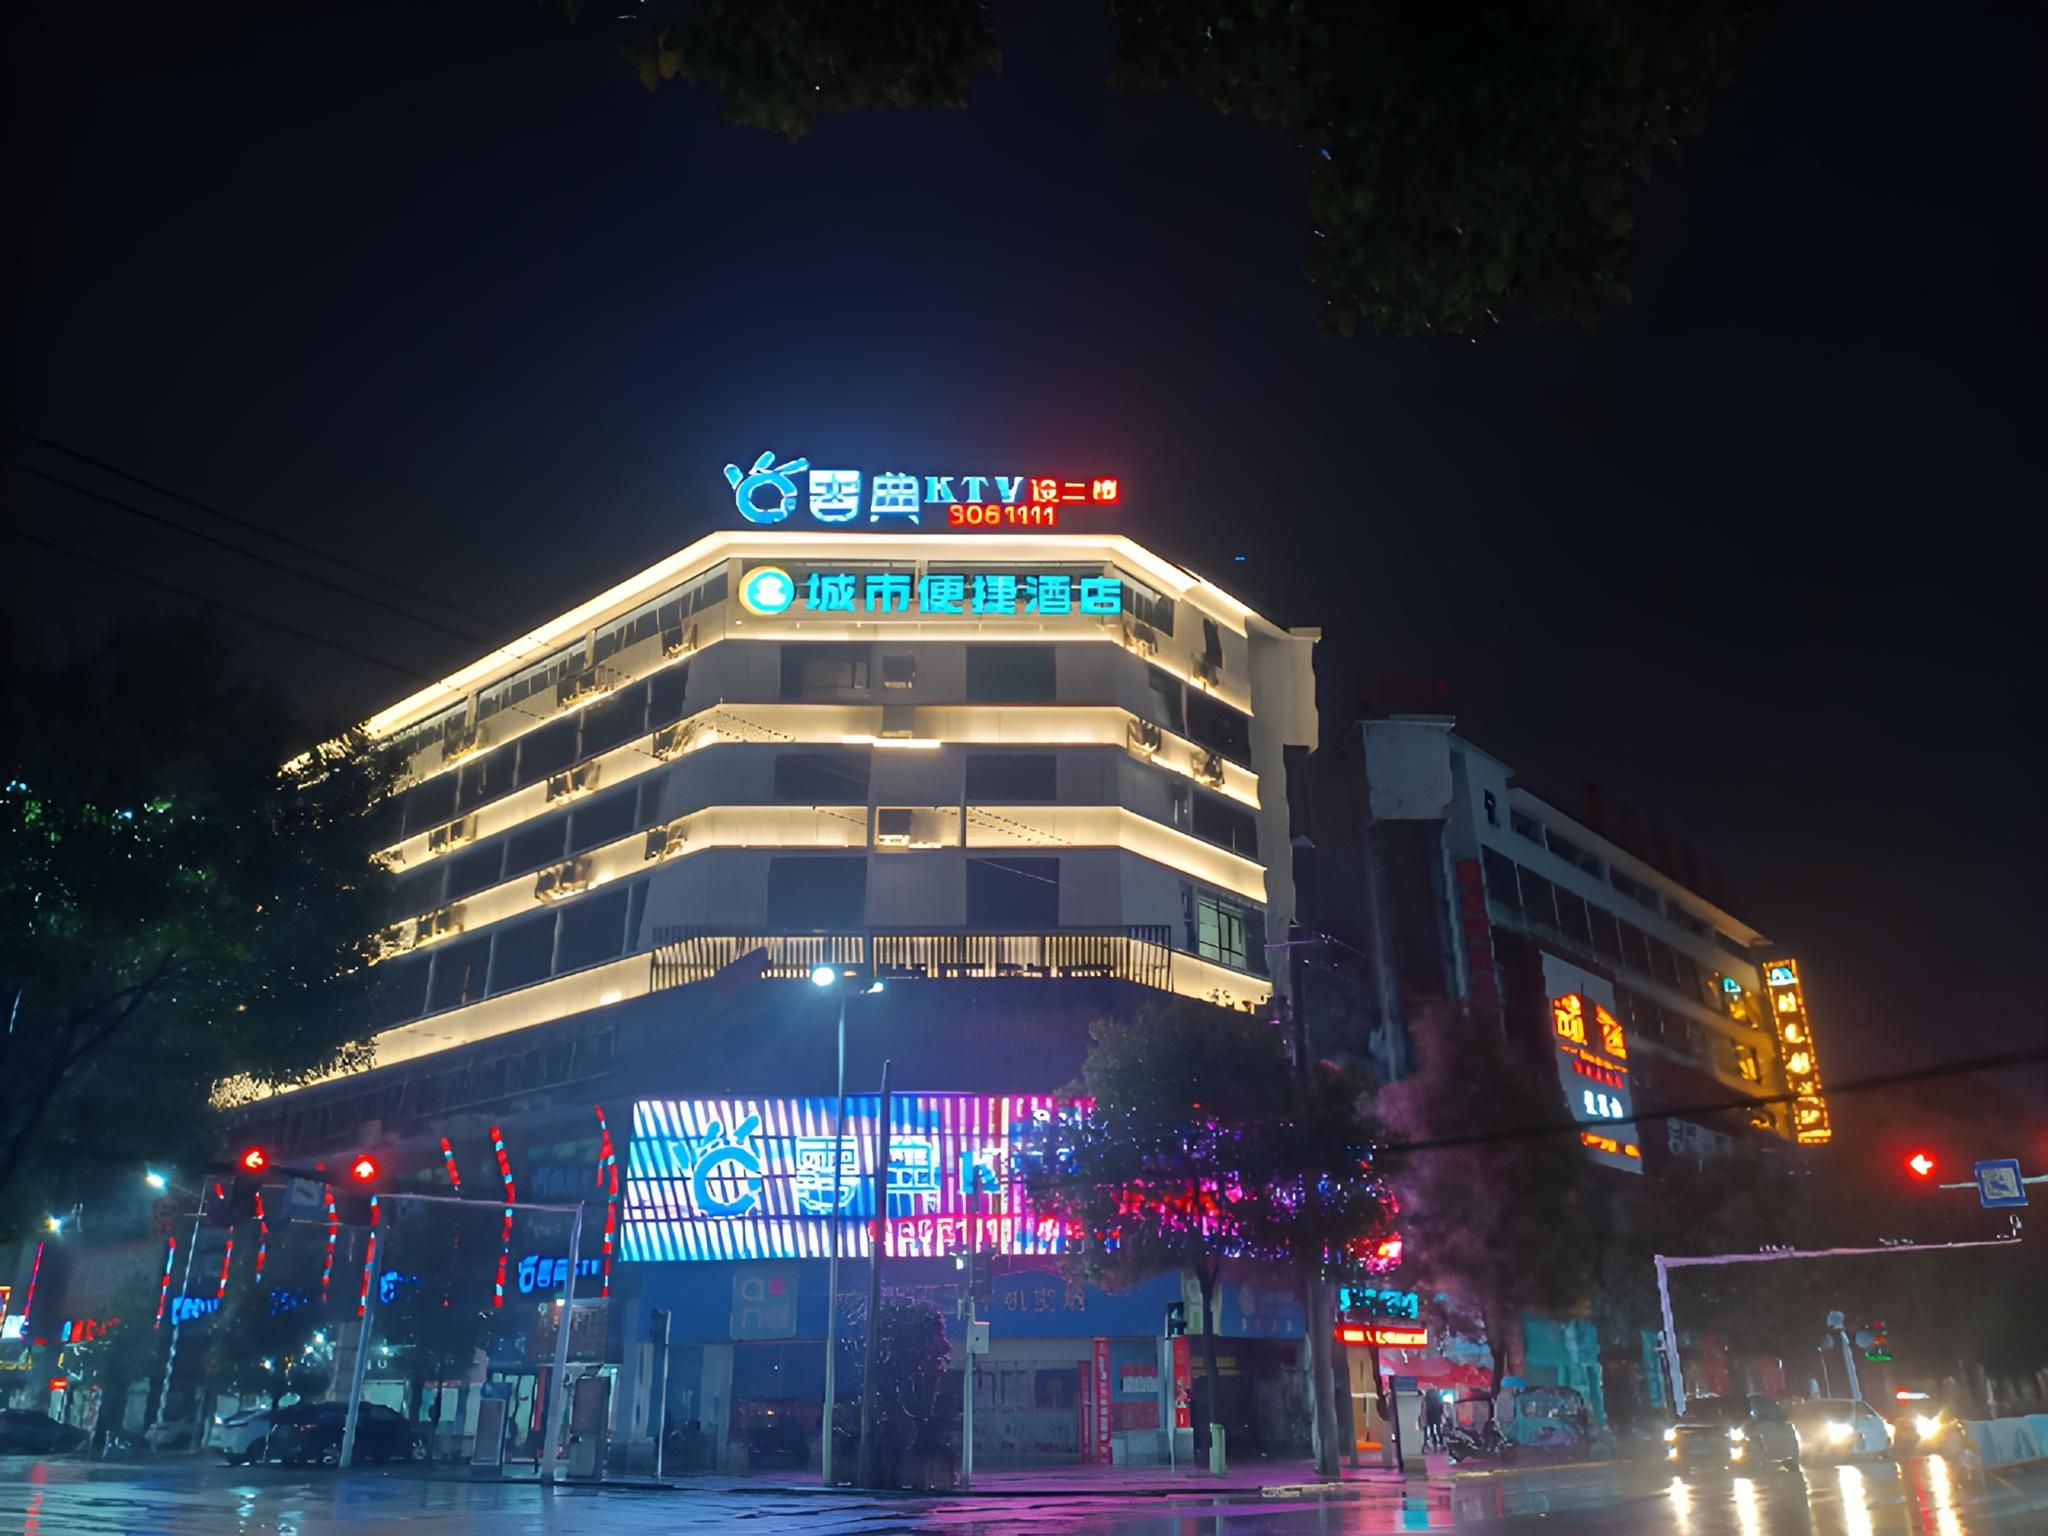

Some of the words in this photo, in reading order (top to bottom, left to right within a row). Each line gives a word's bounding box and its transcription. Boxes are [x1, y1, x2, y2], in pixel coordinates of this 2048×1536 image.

[804, 572, 1123, 615] 城市便捷酒店
